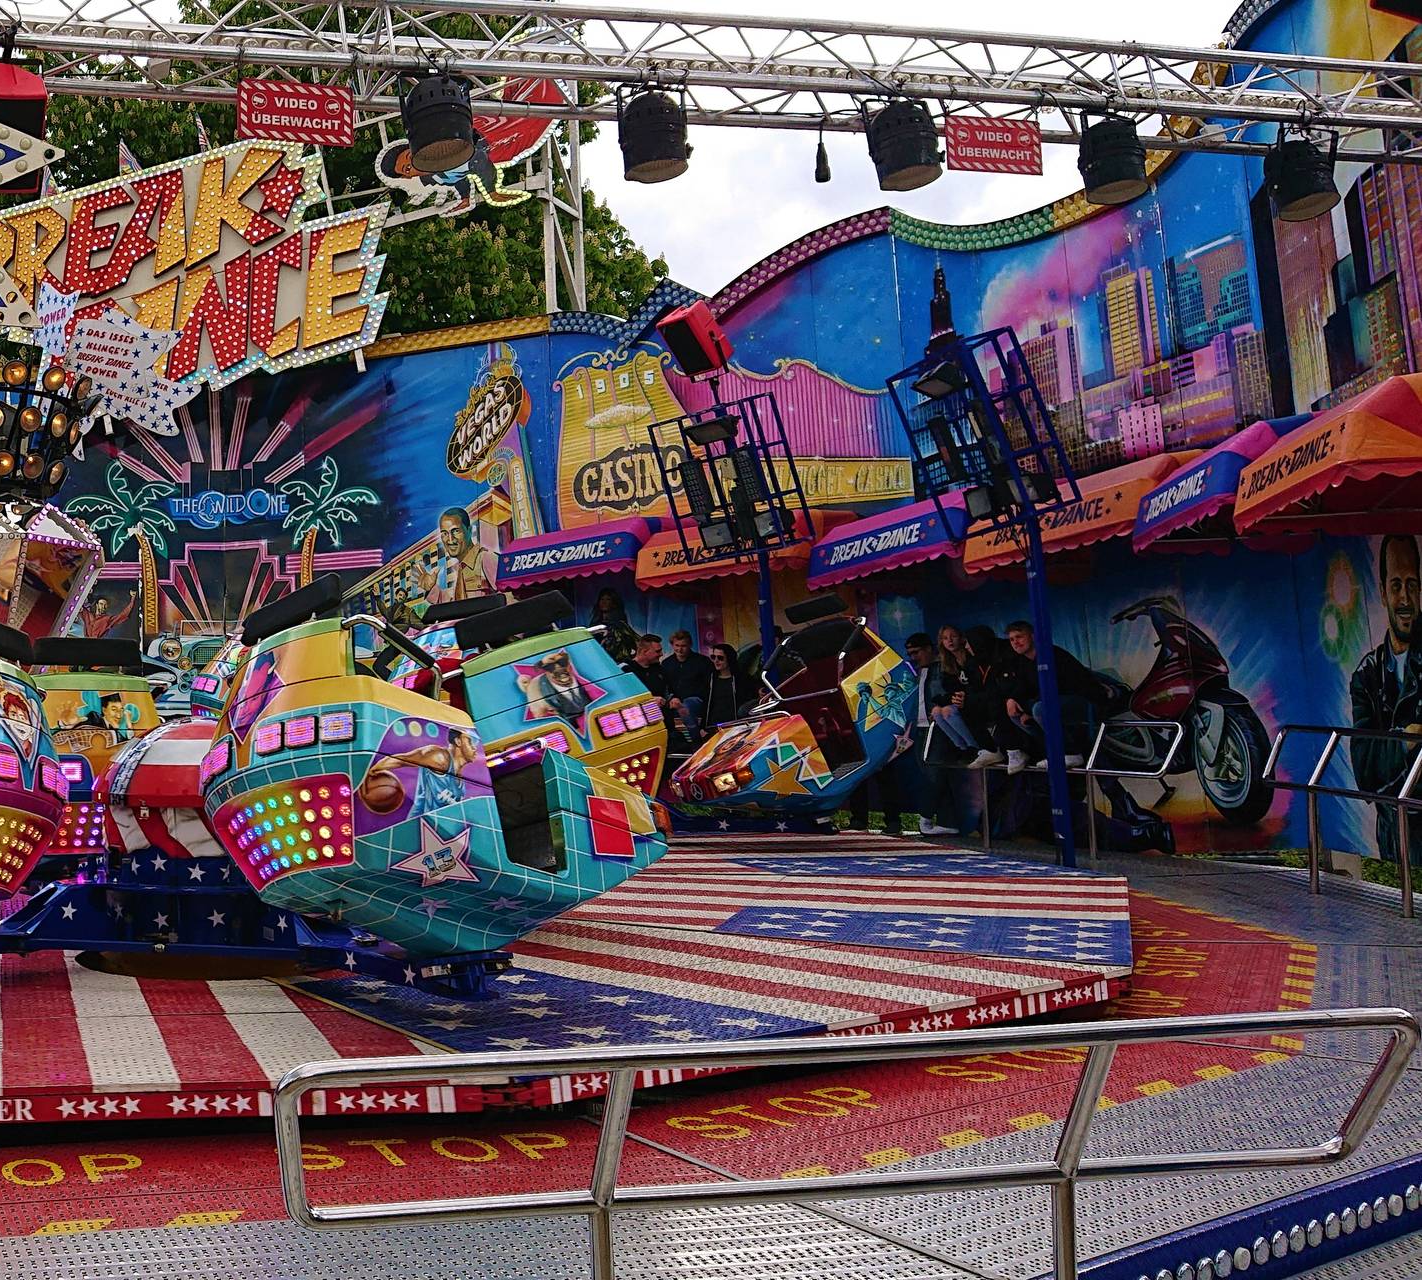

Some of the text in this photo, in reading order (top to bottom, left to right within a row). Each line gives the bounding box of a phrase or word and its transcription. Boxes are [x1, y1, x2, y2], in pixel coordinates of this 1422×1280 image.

[274, 96, 318, 111] VIDEO
[251, 111, 341, 131] ÜBERWACHT
[975, 130, 1012, 143] VIDEO
[958, 144, 1032, 161] ÜBERWACHT
[86, 328, 106, 339] DAS
[86, 341, 129, 357] KLINGE'S
[85, 365, 118, 379] POWER
[105, 357, 134, 371] DANCE
[456, 380, 507, 445] VEGAS
[458, 402, 513, 470] WORLD
[581, 450, 684, 503] CASINO
[1247, 430, 1332, 499] BREAK DANCE
[1177, 469, 1205, 503] DANCE
[171, 488, 289, 524] THE WILD ONE
[1049, 497, 1105, 530] DANCE
[511, 540, 607, 572] BREAK DANCE
[829, 523, 921, 566] BREAK DANCE
[422, 846, 457, 878] 13
[825, 1021, 895, 1037] NGER
[665, 1085, 882, 1140] STOP
[295, 1131, 571, 1171] STOP
